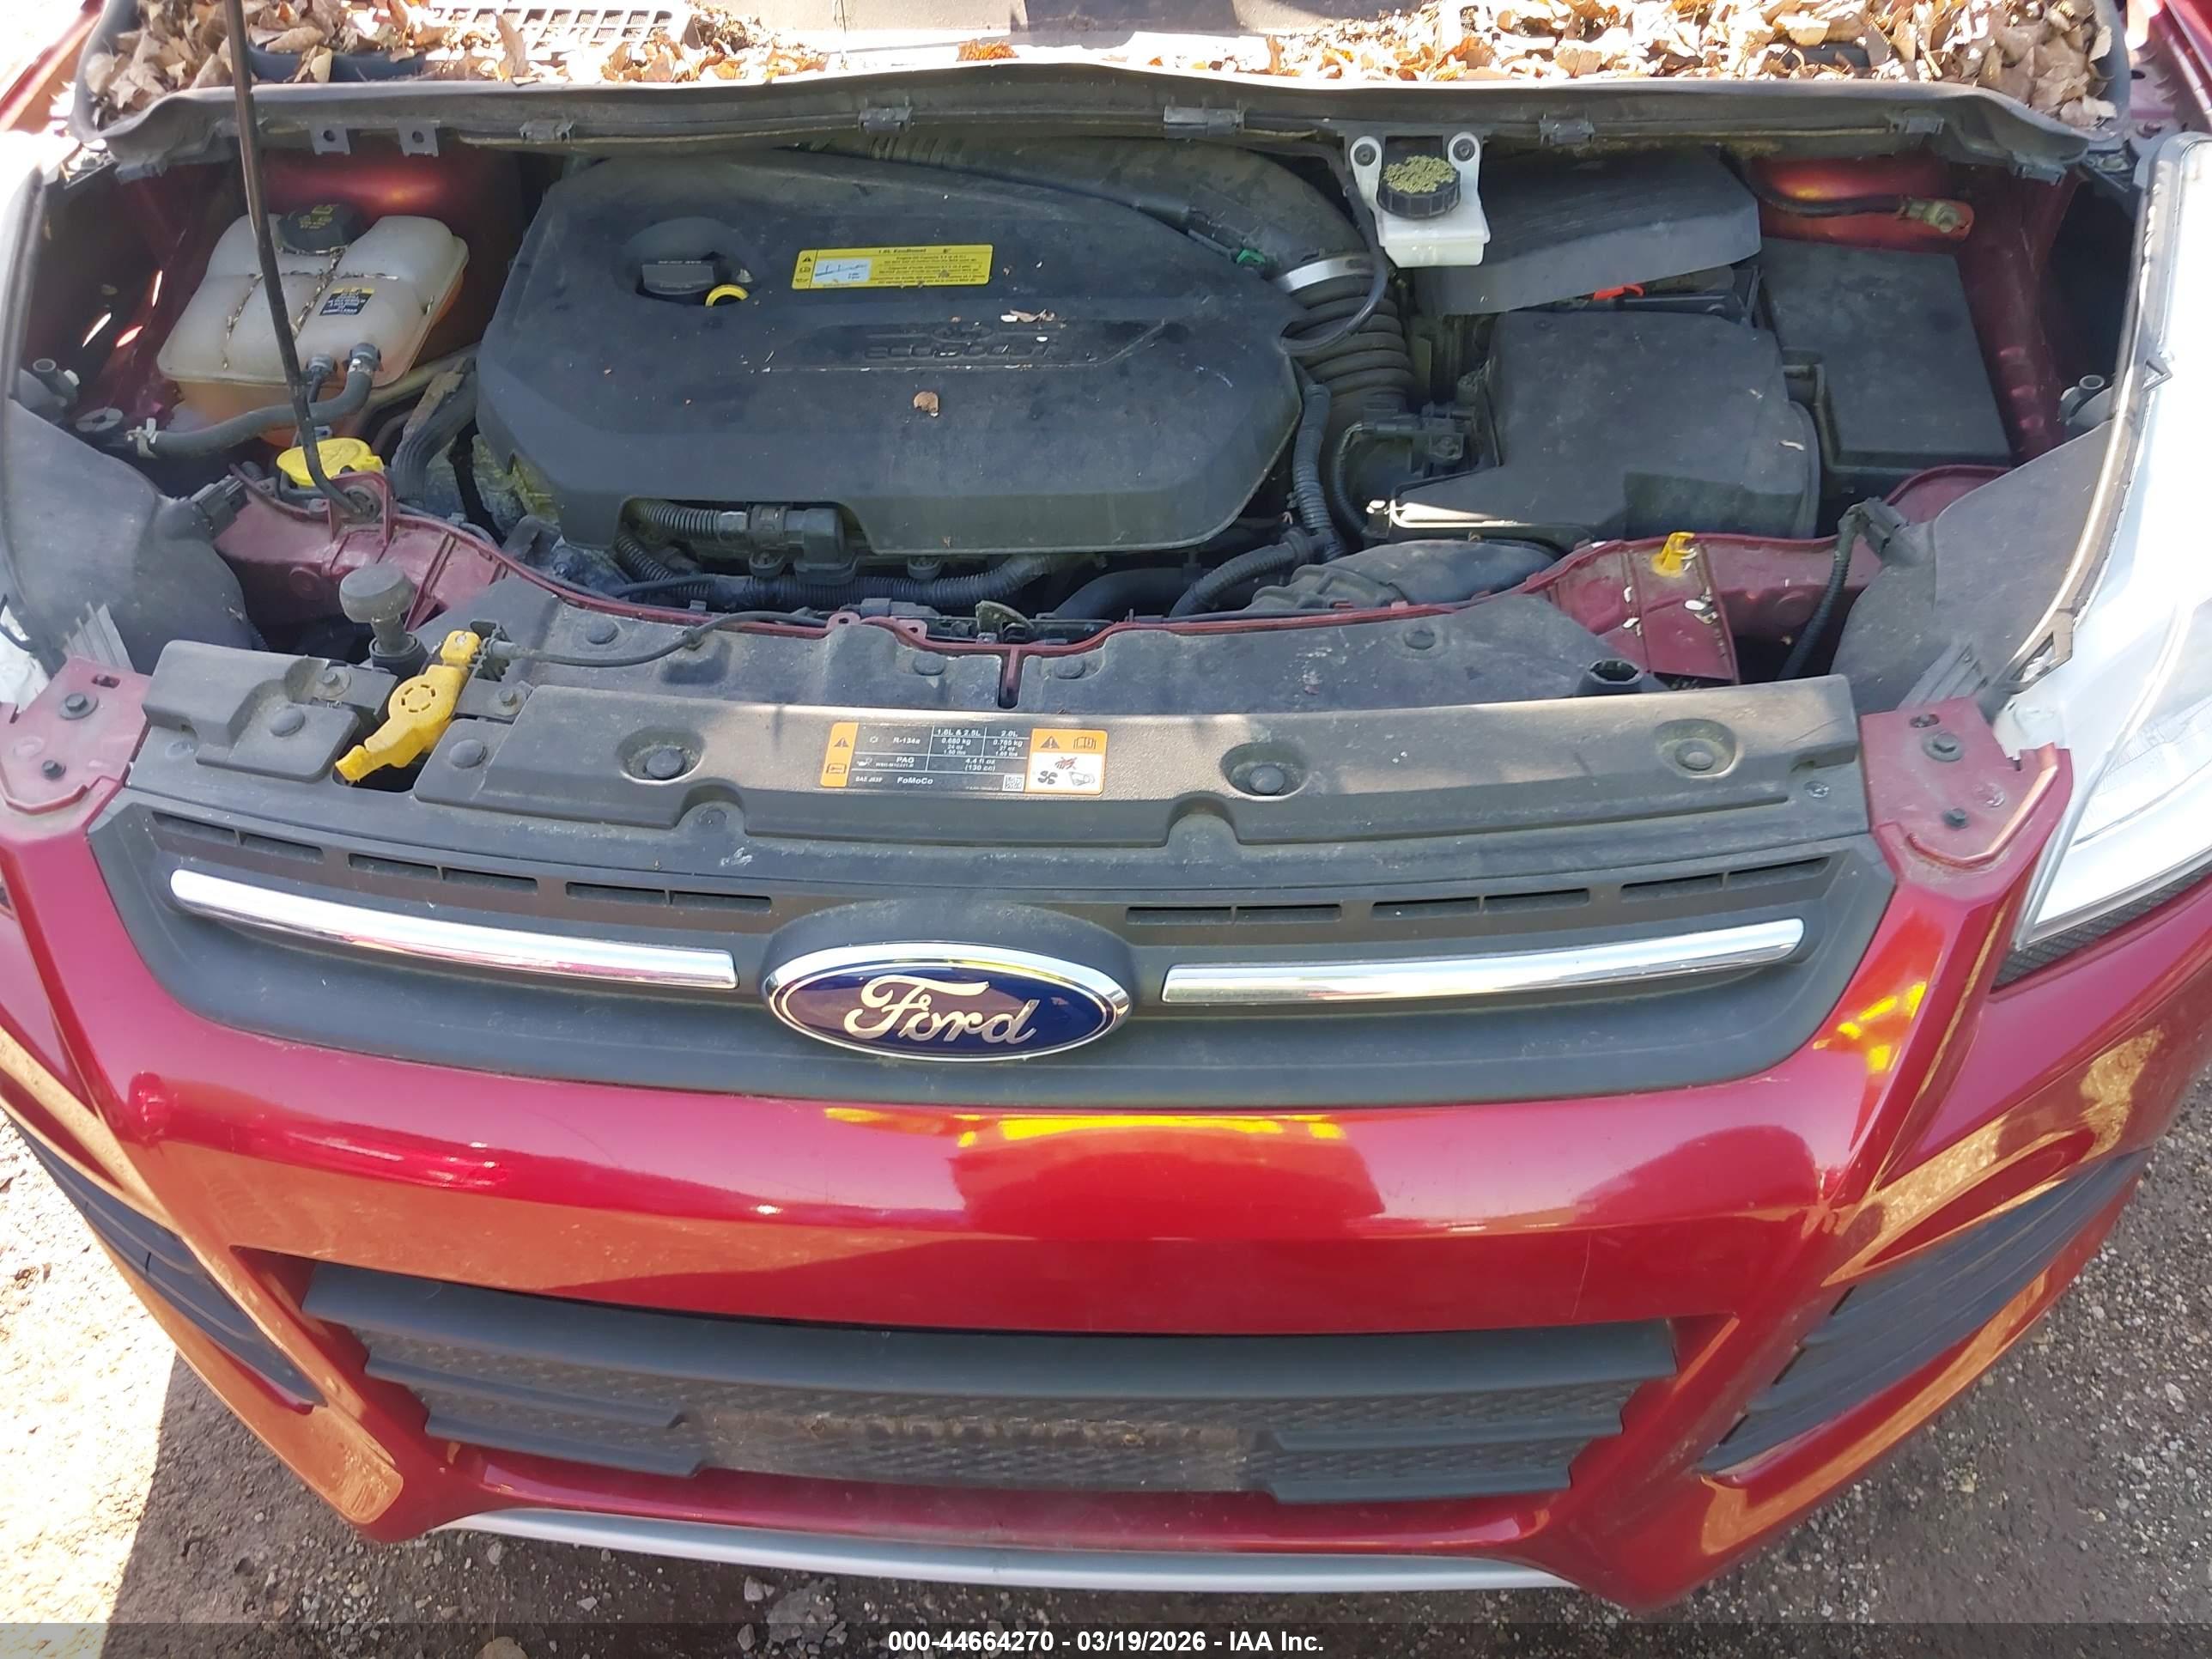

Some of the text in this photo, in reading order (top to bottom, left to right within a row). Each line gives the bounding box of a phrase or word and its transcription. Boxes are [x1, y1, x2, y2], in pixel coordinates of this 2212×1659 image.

[962, 738, 971, 746] kg
[896, 776, 934, 785] FoMoCo
[843, 975, 1037, 1045] Ford
